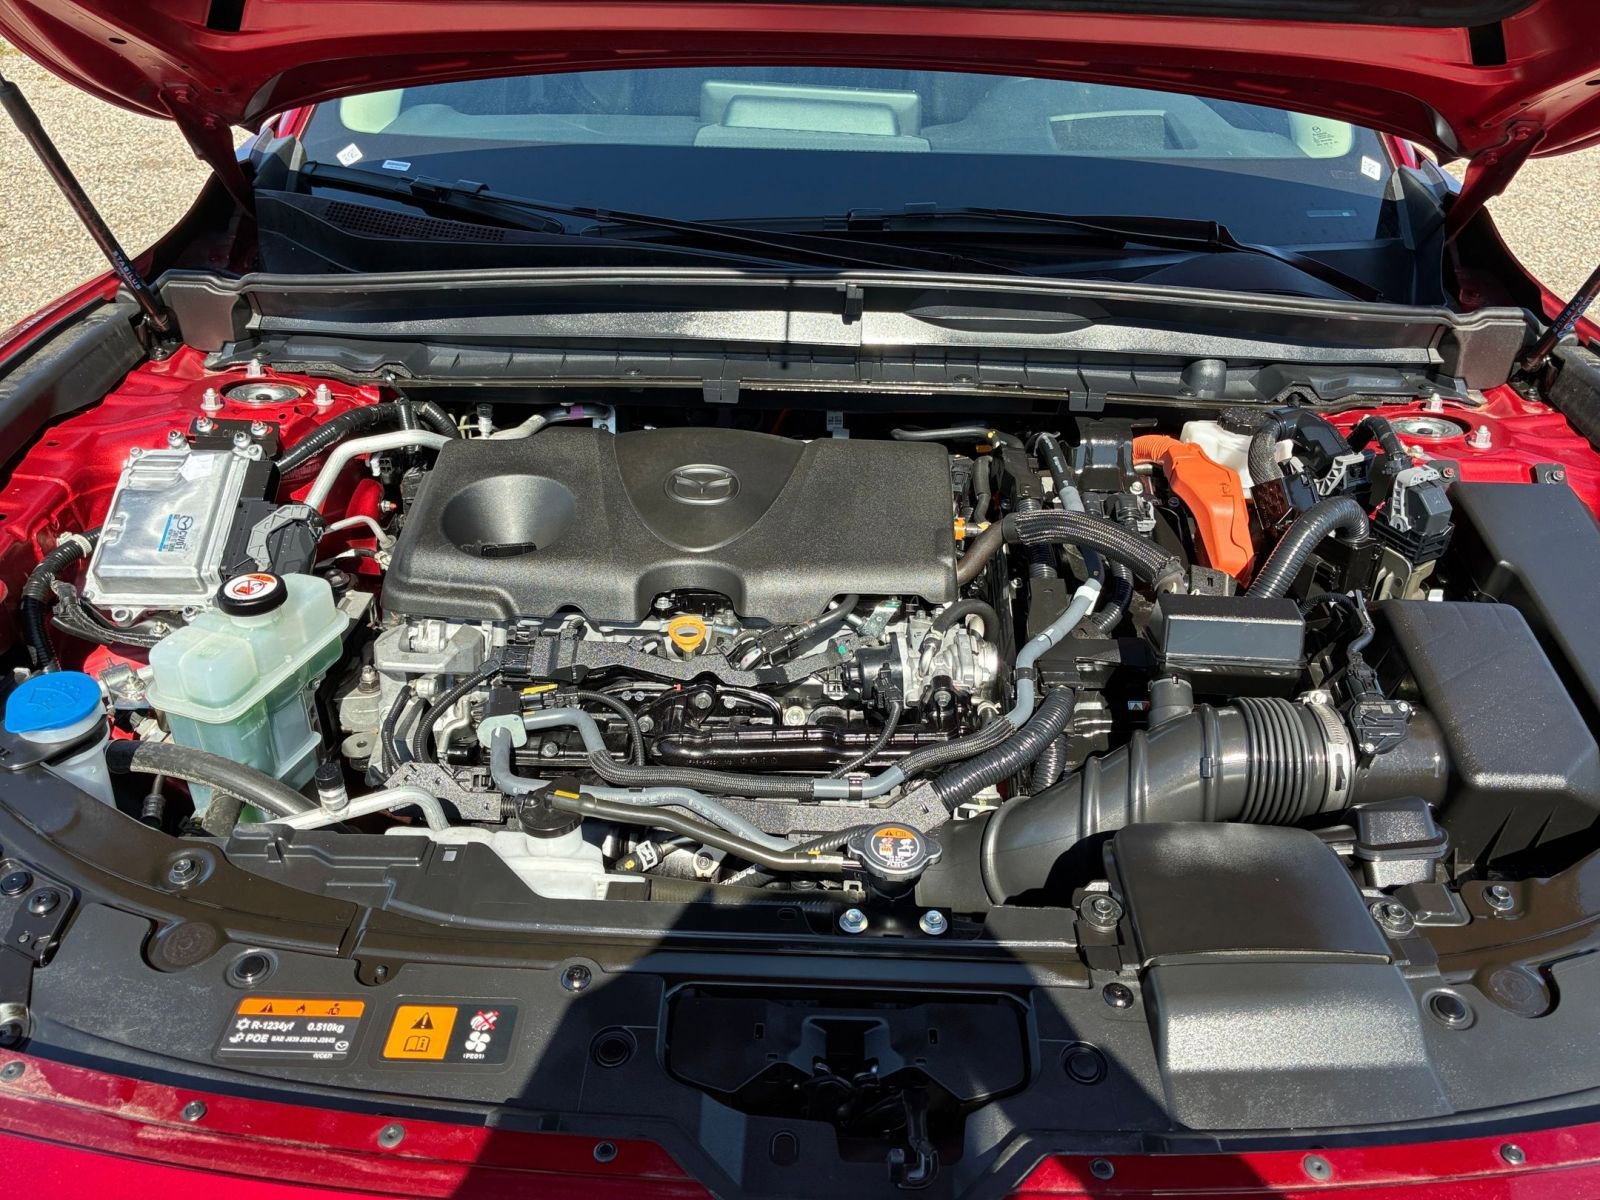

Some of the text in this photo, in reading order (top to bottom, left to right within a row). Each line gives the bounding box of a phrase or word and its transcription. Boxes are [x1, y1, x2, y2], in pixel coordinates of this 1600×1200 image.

[112, 250, 142, 290] STABILUS
[250, 1020, 345, 1034] R-1234yf 0.510kg
[245, 1033, 269, 1043] POE
